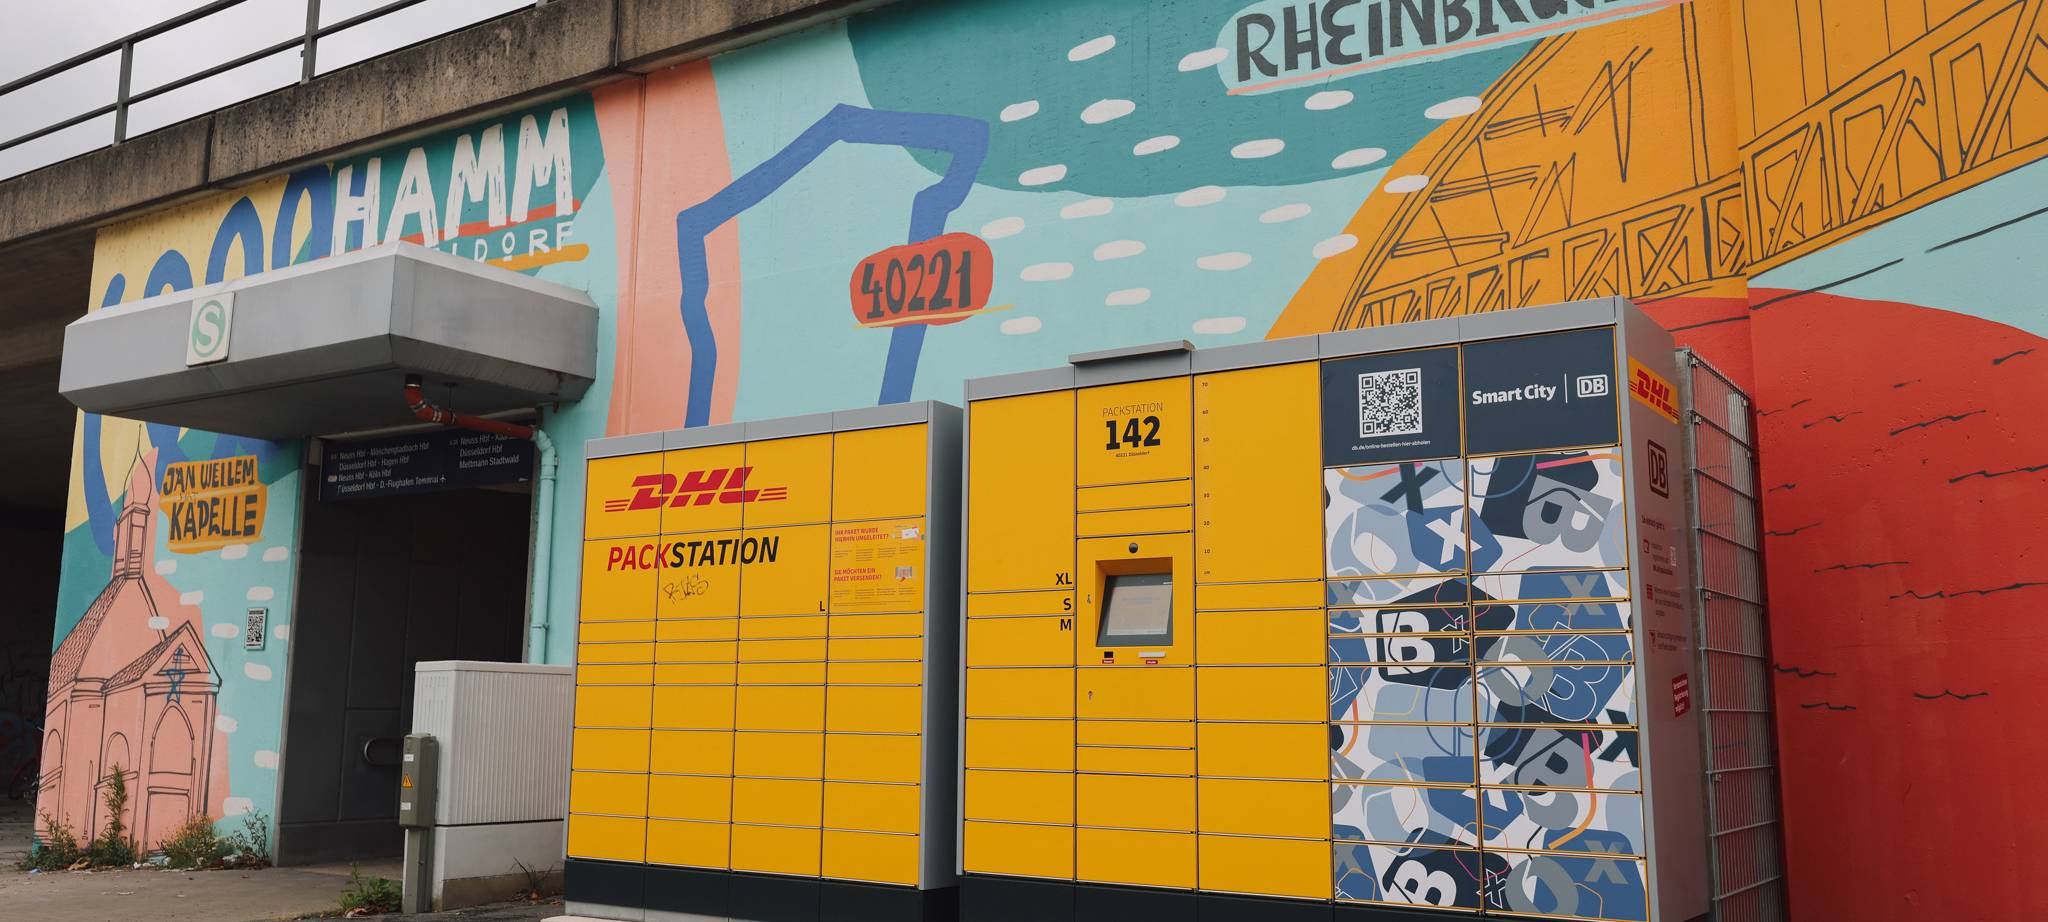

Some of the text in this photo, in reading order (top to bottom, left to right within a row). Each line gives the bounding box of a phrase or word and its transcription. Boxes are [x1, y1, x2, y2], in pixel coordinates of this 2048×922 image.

[330, 106, 574, 257] HAMM
[861, 249, 972, 319] 40221
[192, 301, 225, 357] S
[1472, 376, 1606, 405] Smart City DB
[1636, 367, 1674, 416] DHL
[1102, 402, 1163, 417] PACKSTATION
[1106, 415, 1161, 450] 142
[459, 454, 520, 469] Mettmann Stadtwald
[492, 443, 503, 454] Hbf
[163, 466, 195, 496] JAN
[355, 472, 365, 480] Hbf
[368, 469, 381, 479] Köln
[381, 468, 392, 477] Hbf
[1649, 445, 1668, 494] DB
[627, 466, 761, 511] DHL
[170, 494, 258, 541] KAPELLE
[607, 536, 780, 572] PACKSTATION
[1055, 573, 1073, 586] XL
[819, 600, 826, 612] L
[1063, 598, 1072, 611] S
[1060, 619, 1072, 632] M
